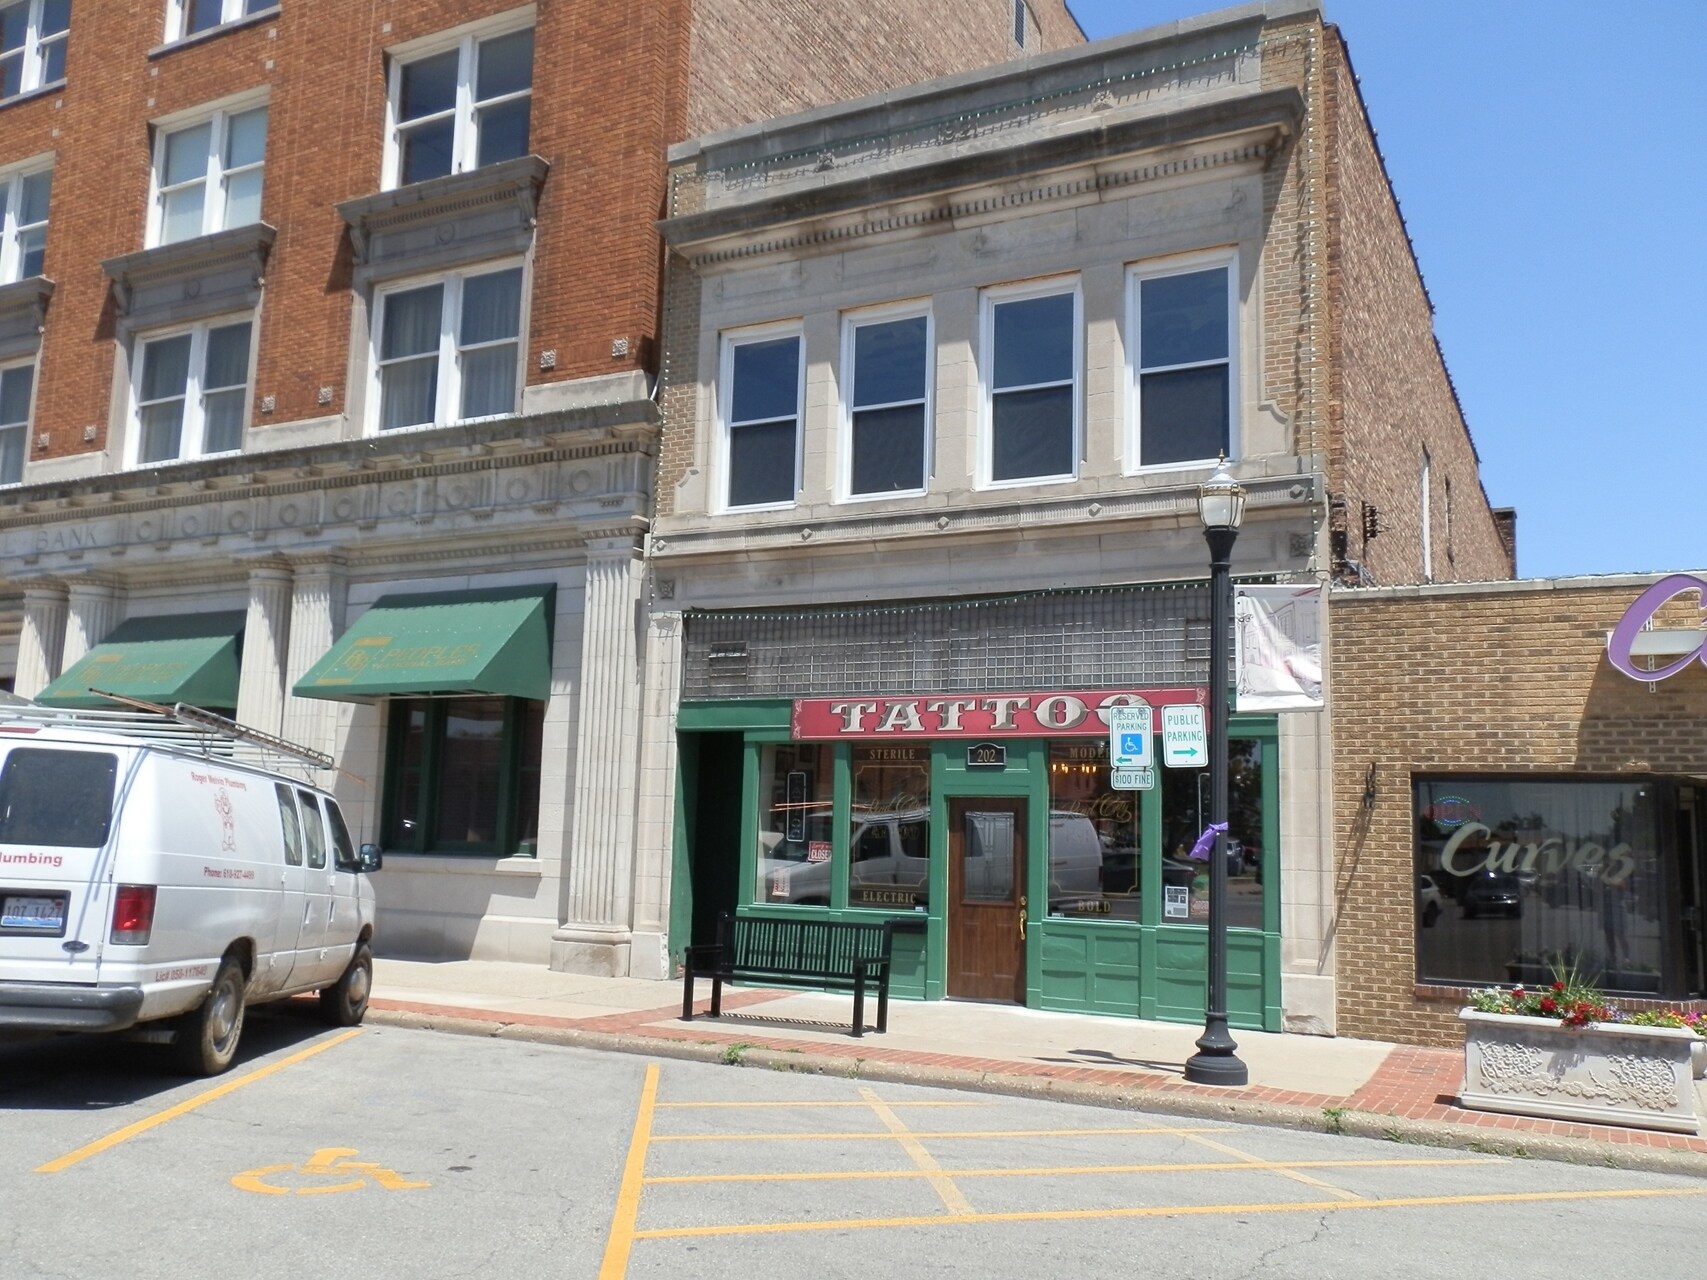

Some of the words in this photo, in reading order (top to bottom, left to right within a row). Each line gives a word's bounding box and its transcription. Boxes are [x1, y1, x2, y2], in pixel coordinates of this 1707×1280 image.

[36, 525, 97, 551] BANK
[1113, 712, 1149, 720] RESERVED
[1167, 714, 1200, 726] PUBLIC
[1116, 722, 1147, 731] PARKING
[1167, 730, 1203, 742] PARKING
[870, 748, 916, 760] STERILE
[977, 749, 996, 763] 202
[1114, 774, 1132, 785] $100
[1134, 774, 1151, 785] FINE
[1440, 821, 1635, 885] Curves
[863, 890, 917, 904] ELECTRIC
[1078, 900, 1112, 914] BOLD
